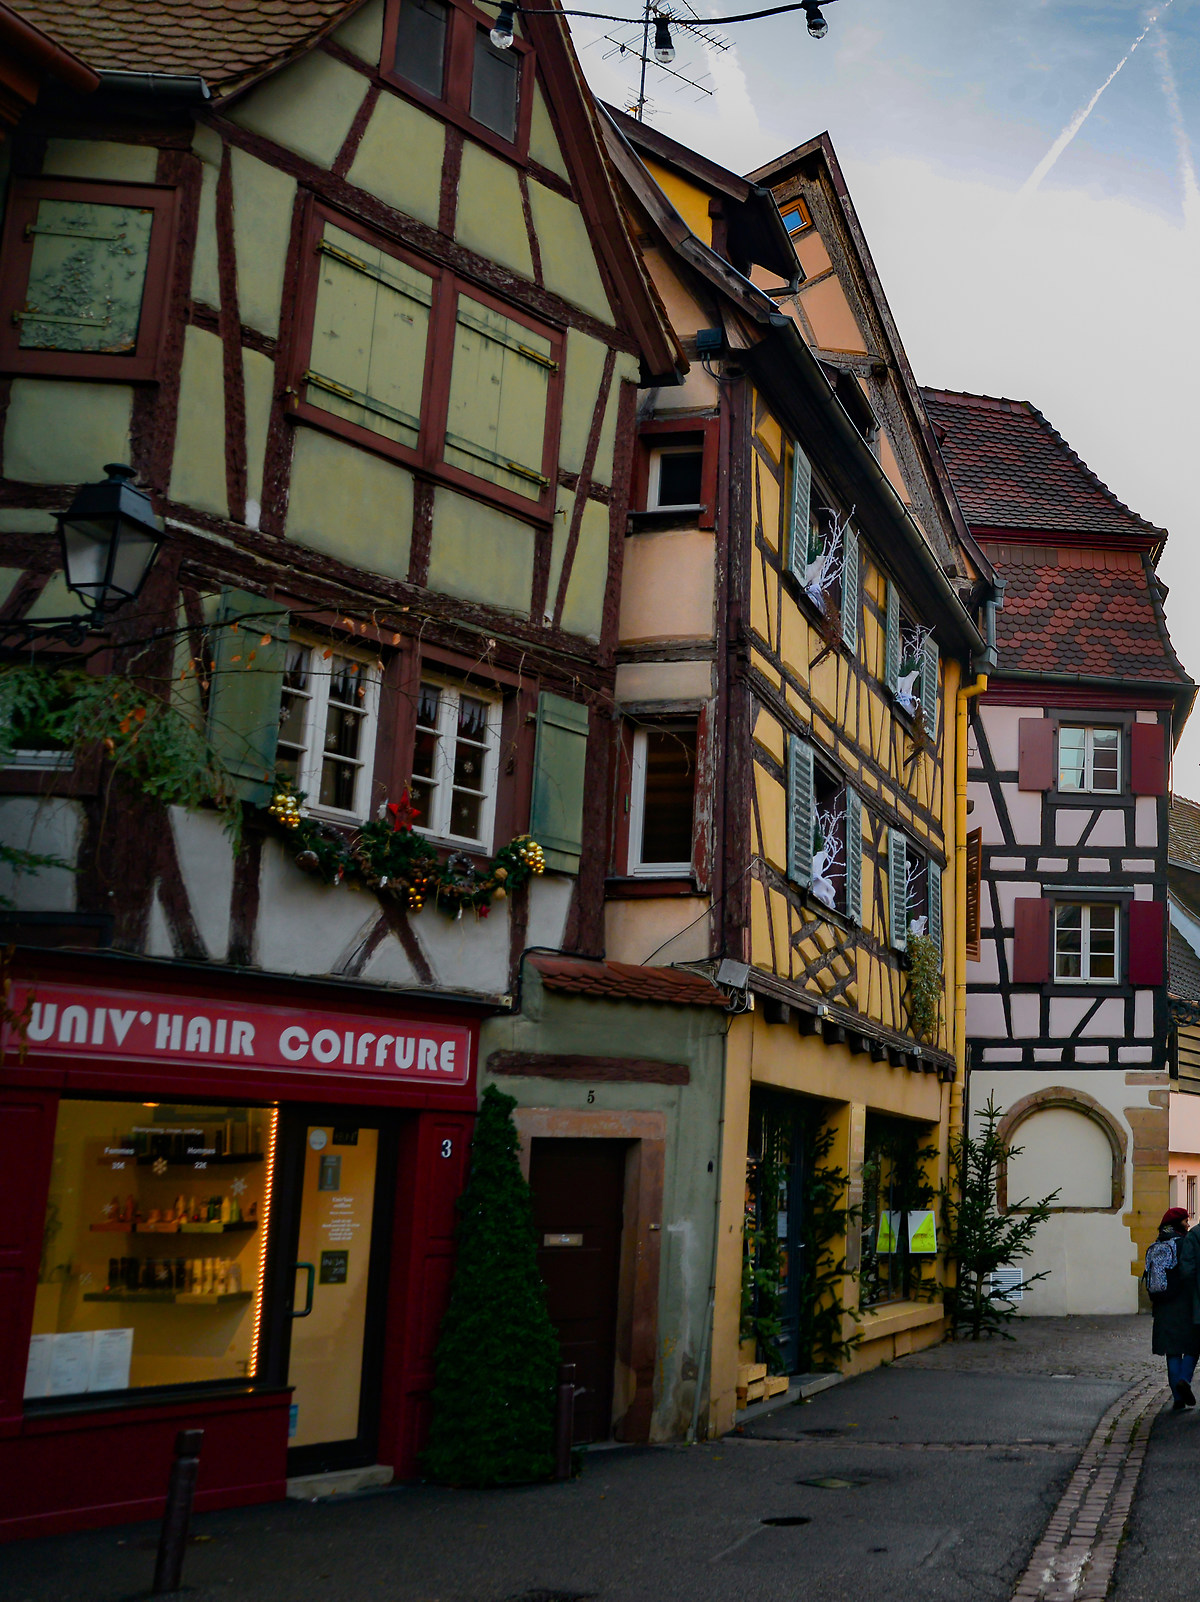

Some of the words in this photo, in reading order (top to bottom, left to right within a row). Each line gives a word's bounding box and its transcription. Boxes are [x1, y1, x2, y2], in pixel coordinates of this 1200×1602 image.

[26, 1002, 256, 1057] UNIV'HAIR
[278, 1025, 457, 1073] COIFFURE
[587, 1090, 595, 1104] 5
[441, 1139, 453, 1158] 3
